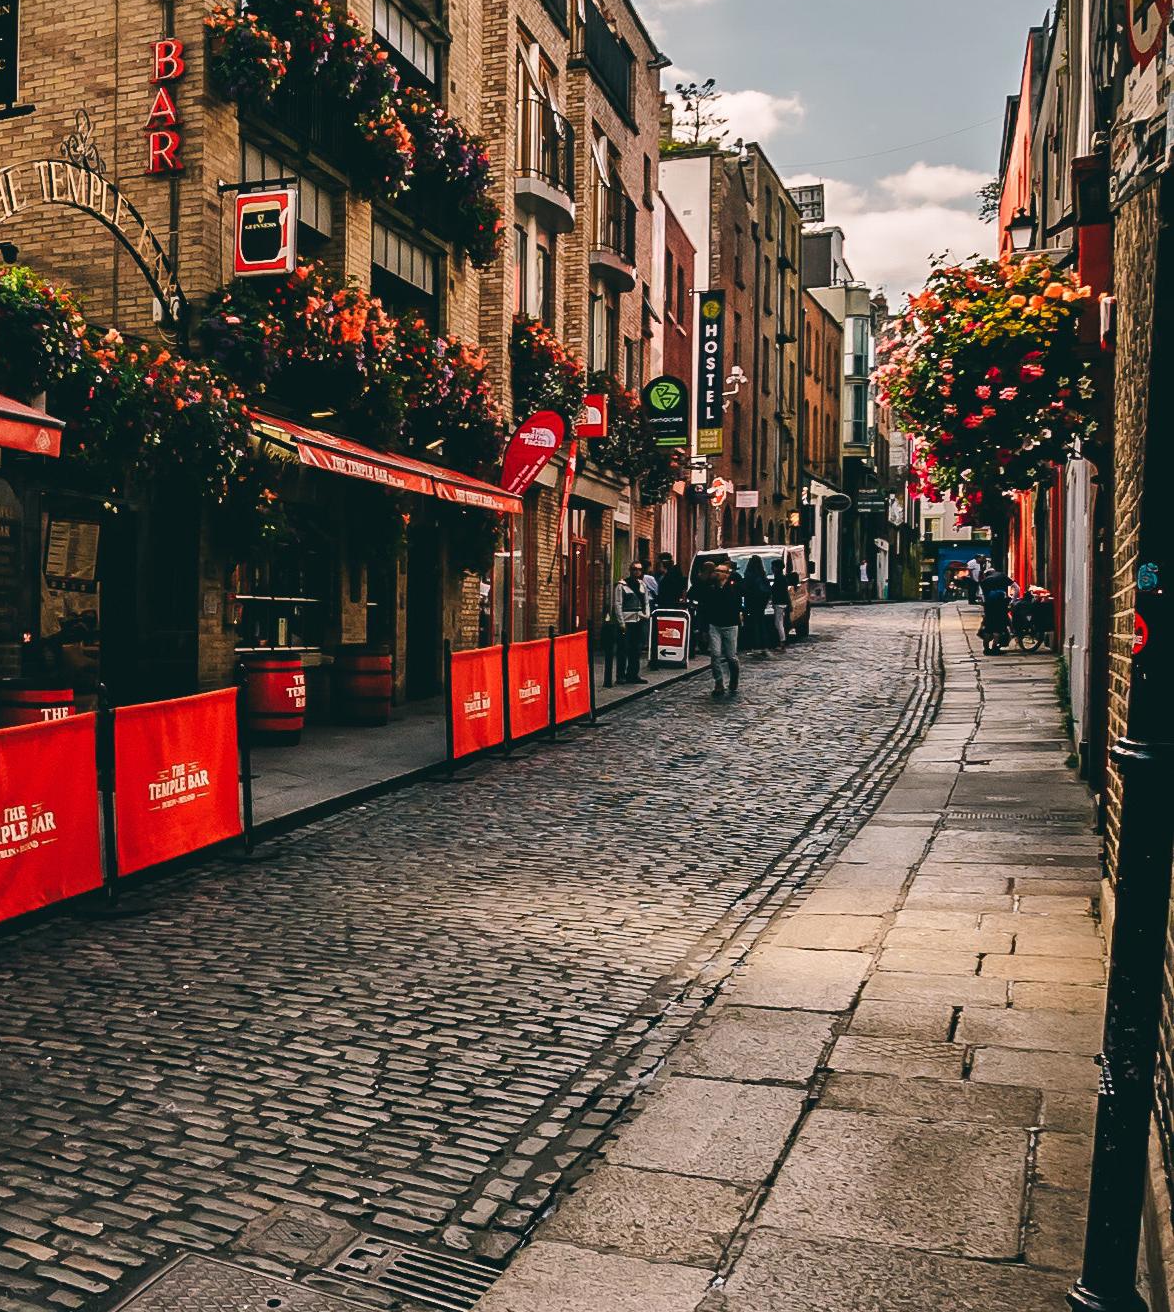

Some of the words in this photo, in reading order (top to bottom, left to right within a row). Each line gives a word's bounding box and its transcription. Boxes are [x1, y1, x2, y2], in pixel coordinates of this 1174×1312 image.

[145, 38, 185, 176] BAR
[35, 161, 128, 232] TEMPLE
[704, 324, 718, 420] HOSTEL
[347, 460, 373, 479] TEMPLE
[41, 707, 68, 721] THE
[172, 763, 185, 778] THE
[149, 776, 186, 800] TEMPLE
[187, 770, 209, 790] BAR
[4, 805, 27, 823] THE
